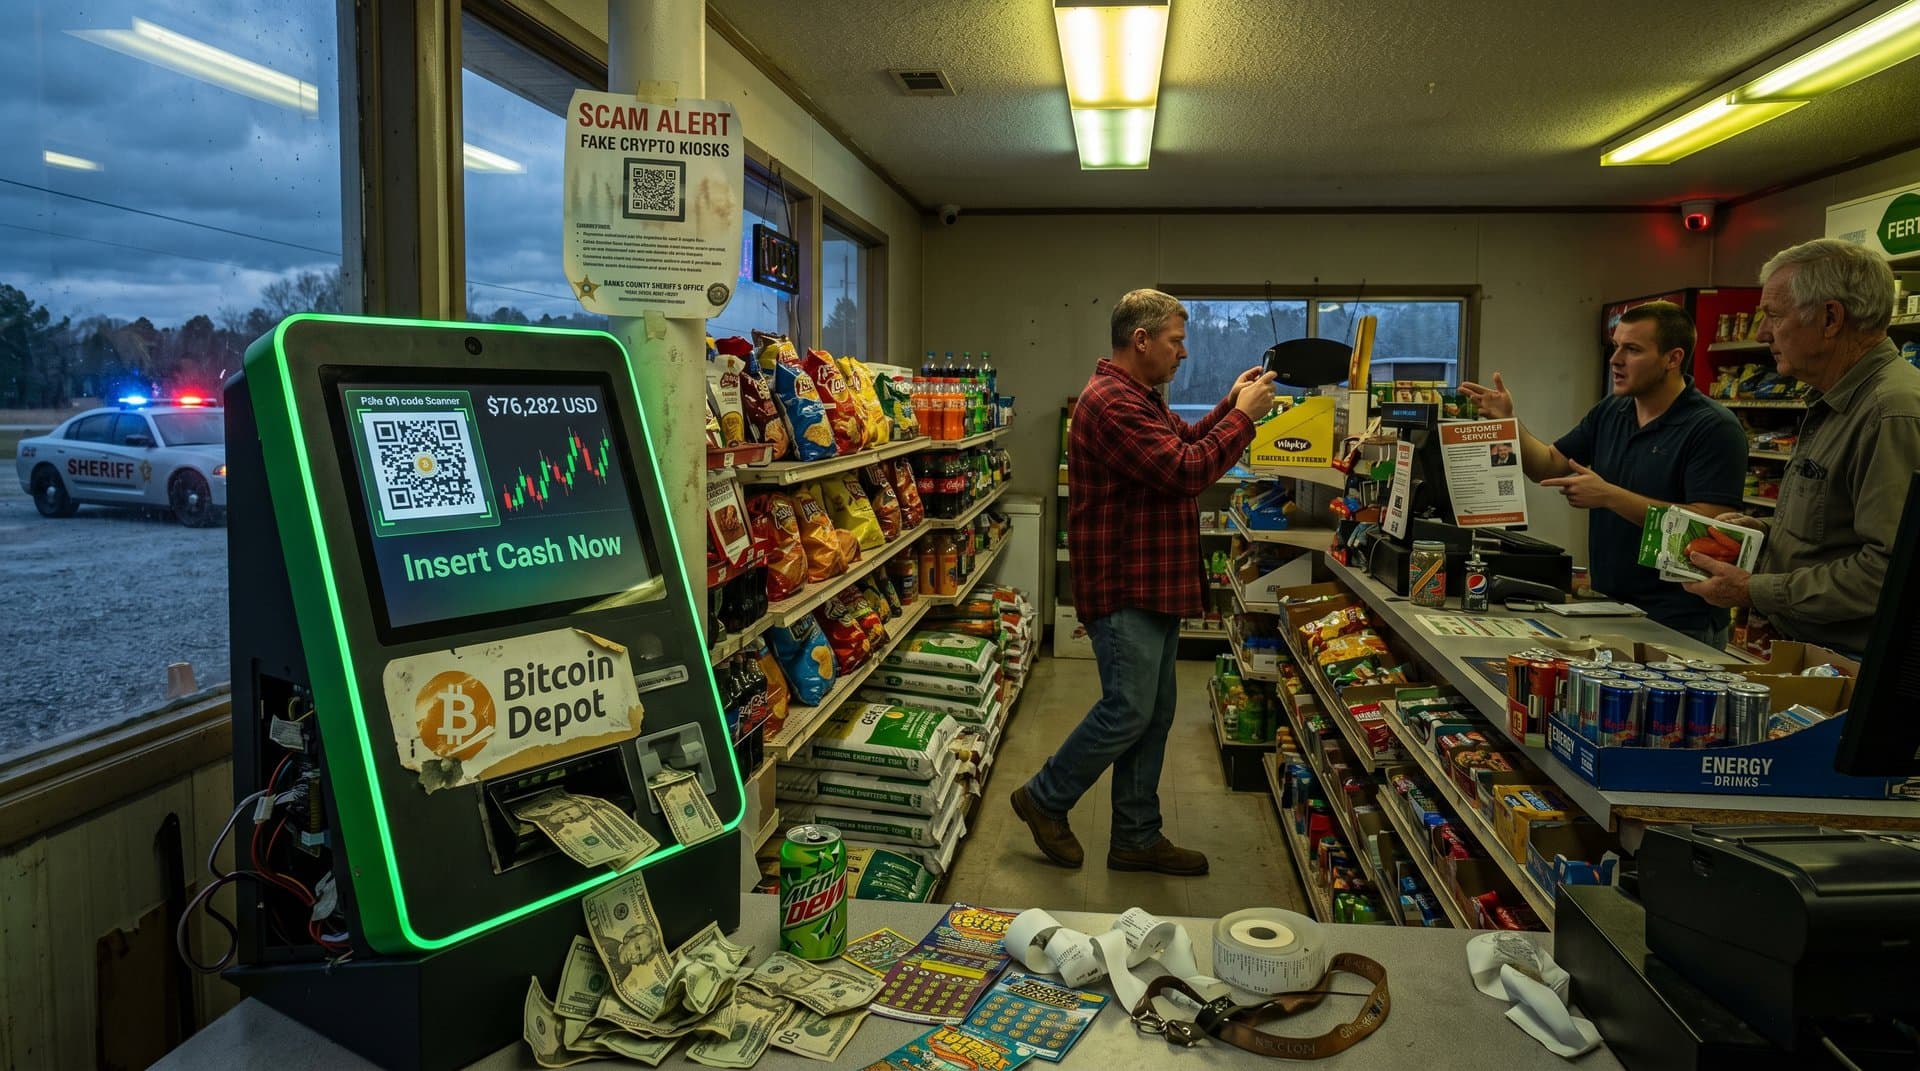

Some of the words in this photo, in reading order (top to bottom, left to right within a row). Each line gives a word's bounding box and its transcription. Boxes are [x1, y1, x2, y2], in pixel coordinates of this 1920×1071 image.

[579, 102, 648, 130] SCAM
[656, 109, 731, 136] ALERT
[581, 134, 616, 150] FAKE
[620, 137, 675, 154] CRYPTO
[679, 141, 729, 157] KIOSKS
[603, 279, 624, 287] BANKS
[625, 281, 651, 289] COUNTY
[401, 396, 424, 405] code
[425, 396, 460, 405] Scanner
[487, 396, 560, 417] $76,282
[562, 396, 598, 414] USD
[1454, 424, 1502, 434] CUSTOMER
[1462, 432, 1498, 441] SERVICE
[67, 458, 134, 480] SHERIFF
[403, 547, 491, 582] Insert
[497, 537, 564, 570] Cash
[568, 534, 621, 561] Now
[504, 651, 613, 701] Bitcoin
[508, 689, 607, 740] Depot
[1552, 725, 1574, 754] ENERGY
[1702, 756, 1773, 776] ENERGY
[1714, 775, 1760, 788] DRINKS
